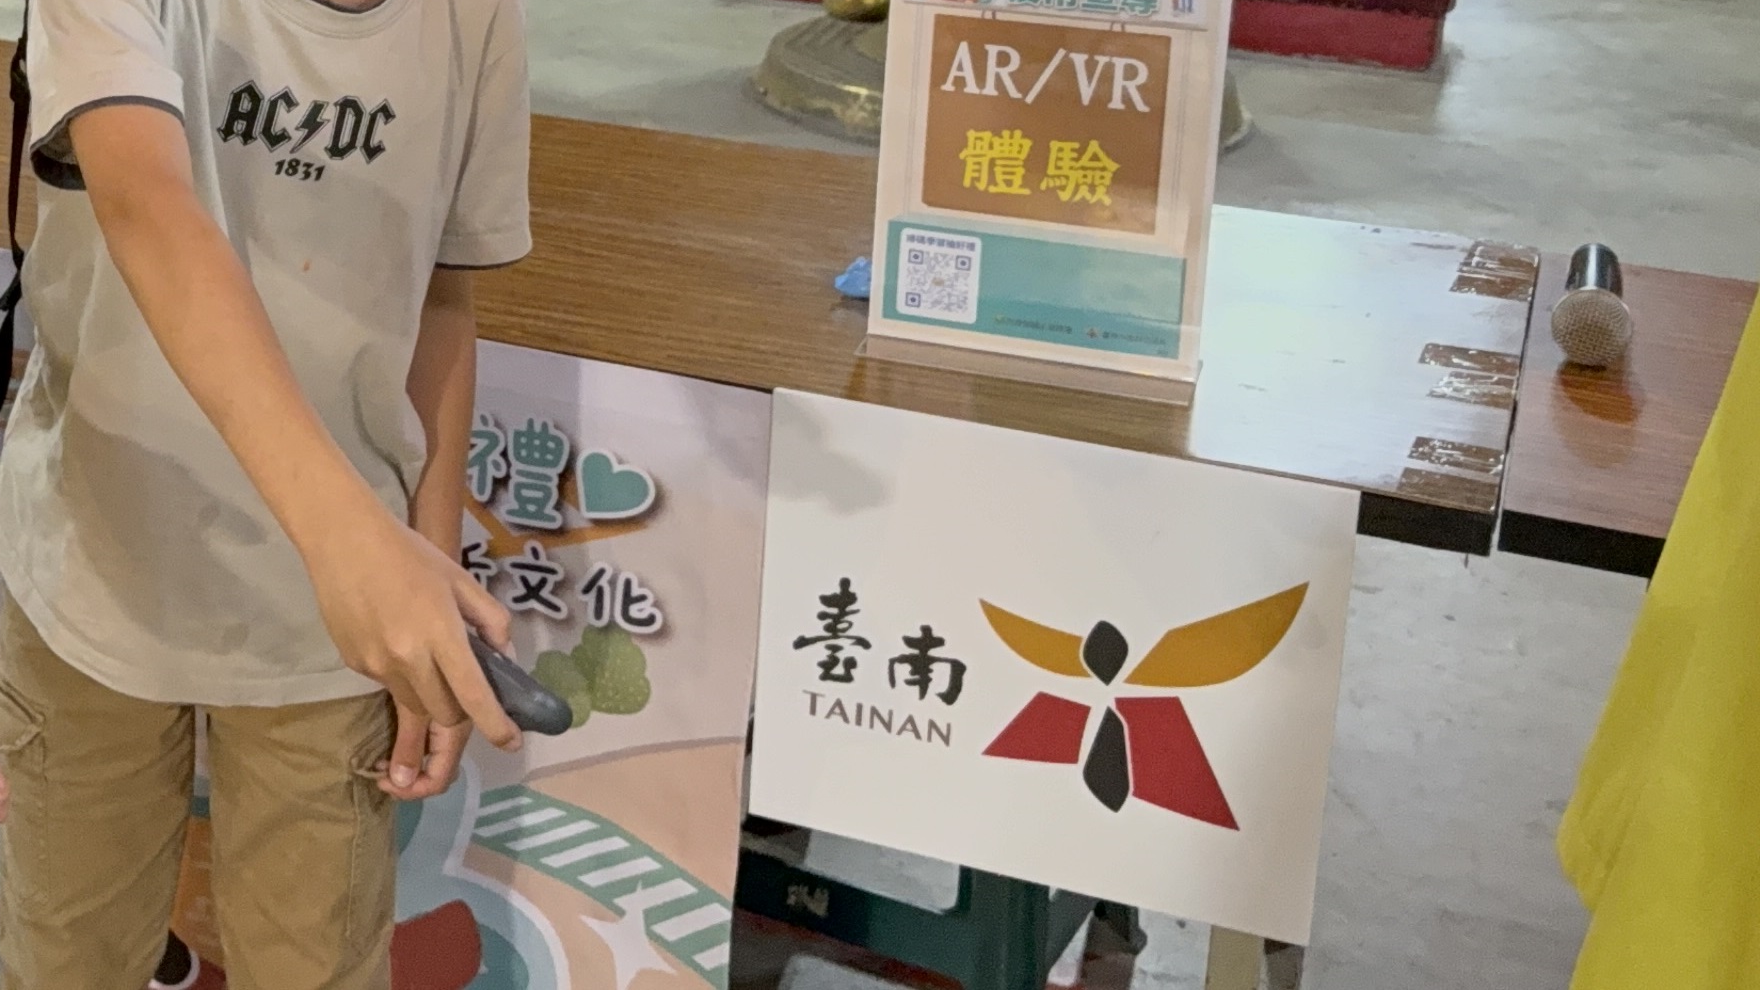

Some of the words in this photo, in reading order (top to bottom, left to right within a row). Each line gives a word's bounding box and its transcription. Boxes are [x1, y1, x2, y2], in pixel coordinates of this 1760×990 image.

[940, 39, 1152, 114] AR/VR
[273, 158, 327, 183] 1831
[958, 127, 1121, 207] 體驗
[792, 576, 967, 706] 臺南
[802, 689, 955, 748] TAINAN
